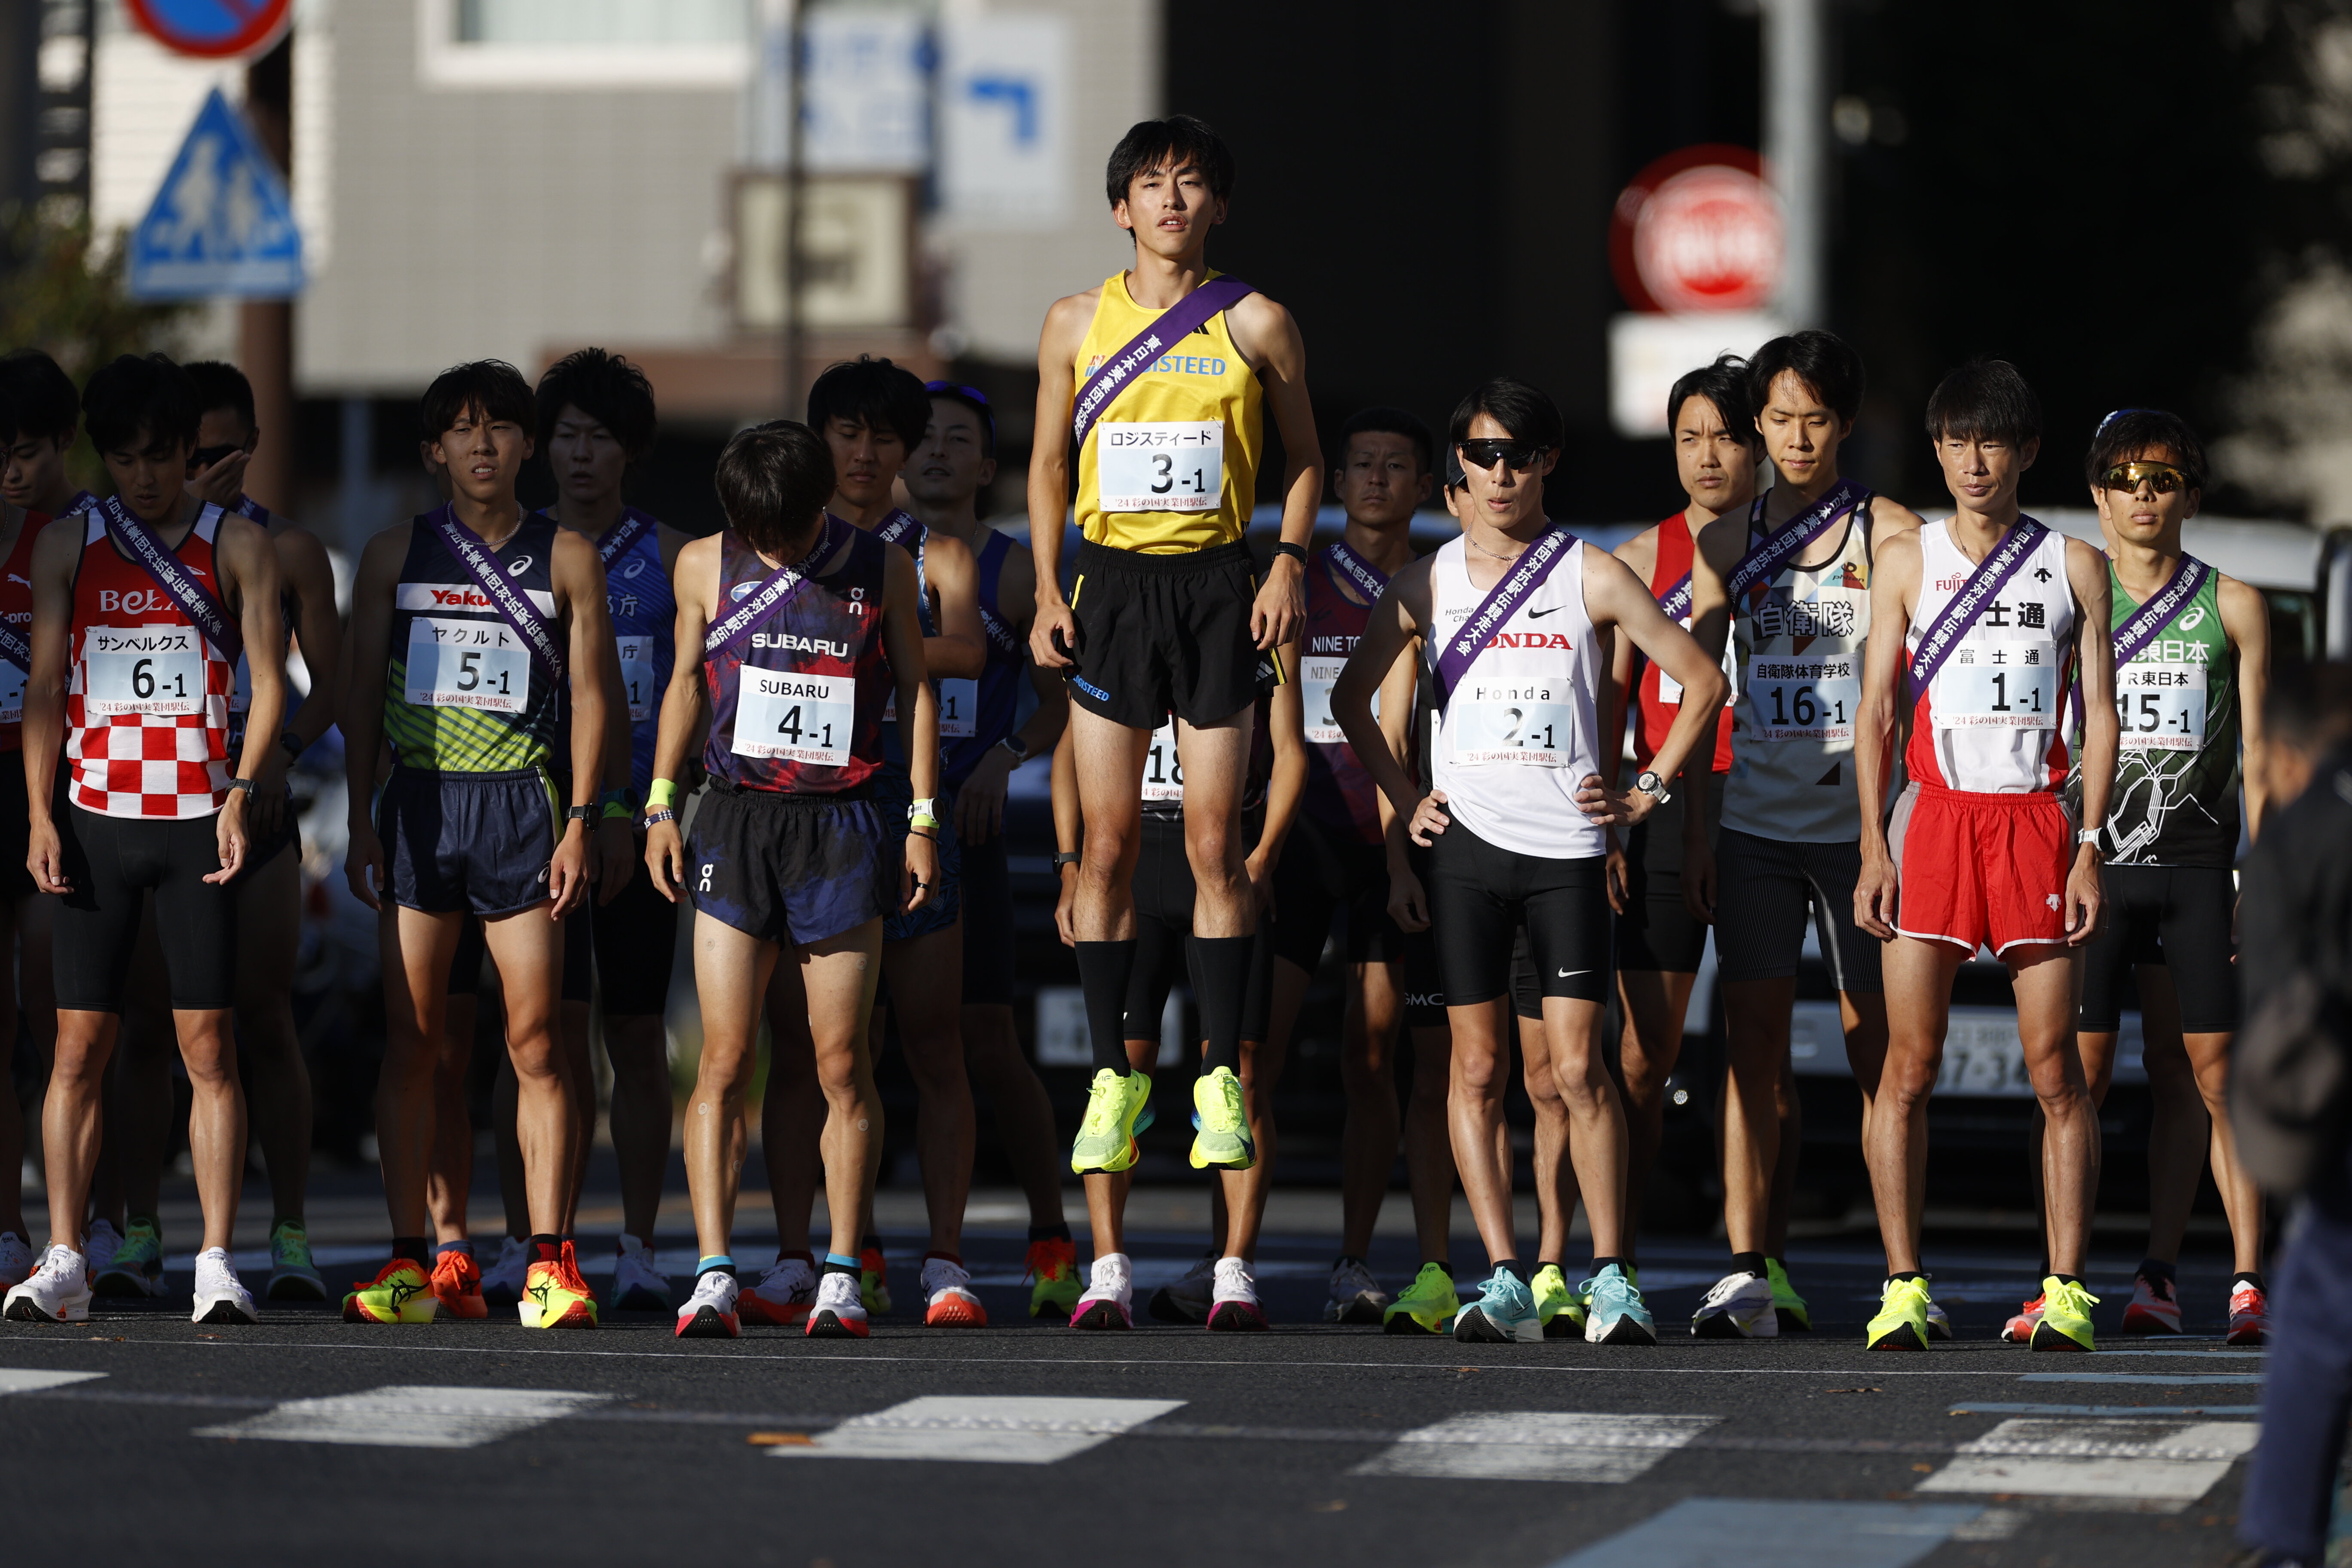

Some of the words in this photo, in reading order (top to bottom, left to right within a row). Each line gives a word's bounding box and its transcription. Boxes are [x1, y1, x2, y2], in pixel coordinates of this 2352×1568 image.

[1111, 431, 1211, 446] ロジスティード
[1152, 454, 1205, 493] 3-1
[1132, 496, 1207, 507] 彩の国実業団駅伝
[104, 495, 223, 636] 東日本実業団対抗駅伝競走大会
[430, 590, 495, 606] Yaku
[441, 523, 563, 680] 東日本実業団対抗駅伝競走大会
[1913, 521, 2038, 680] 東日本実業団対抗駅伝競走大会
[1446, 606, 1474, 616] Honda
[1758, 600, 1854, 637] 自衛隊
[1972, 600, 2046, 629] 士通
[98, 636, 189, 651] サンベルクス
[432, 627, 509, 647] ヤクルト
[752, 633, 848, 657] SUBARU
[1312, 636, 1343, 653] NINE
[1960, 649, 2040, 665] 富士通
[2131, 640, 2210, 664] 東日本
[132, 658, 187, 699] 6-1
[457, 652, 510, 695] 5-1
[1311, 667, 1339, 679] NINE
[1757, 662, 1850, 679] 自衛隊体育学校
[760, 680, 829, 699] SUBARU
[1476, 686, 1550, 700] Honda
[1992, 673, 2041, 712] 1-1
[99, 702, 112, 711] '24
[114, 701, 190, 712] 彩の国実業団駅伝
[436, 693, 512, 709] 彩の国実業団駅伝
[1770, 686, 1847, 726] 16-1
[1969, 716, 2043, 726] 彩の国実業団駅伝
[2117, 694, 2191, 733] 15-1
[778, 705, 833, 748] 4-1
[1502, 708, 1555, 749] 2-1
[1775, 728, 1849, 739] 彩の国実業団駅伝
[757, 745, 834, 762] 彩の国実業団駅伝
[1482, 751, 1557, 763] 彩の国実業団駅伝
